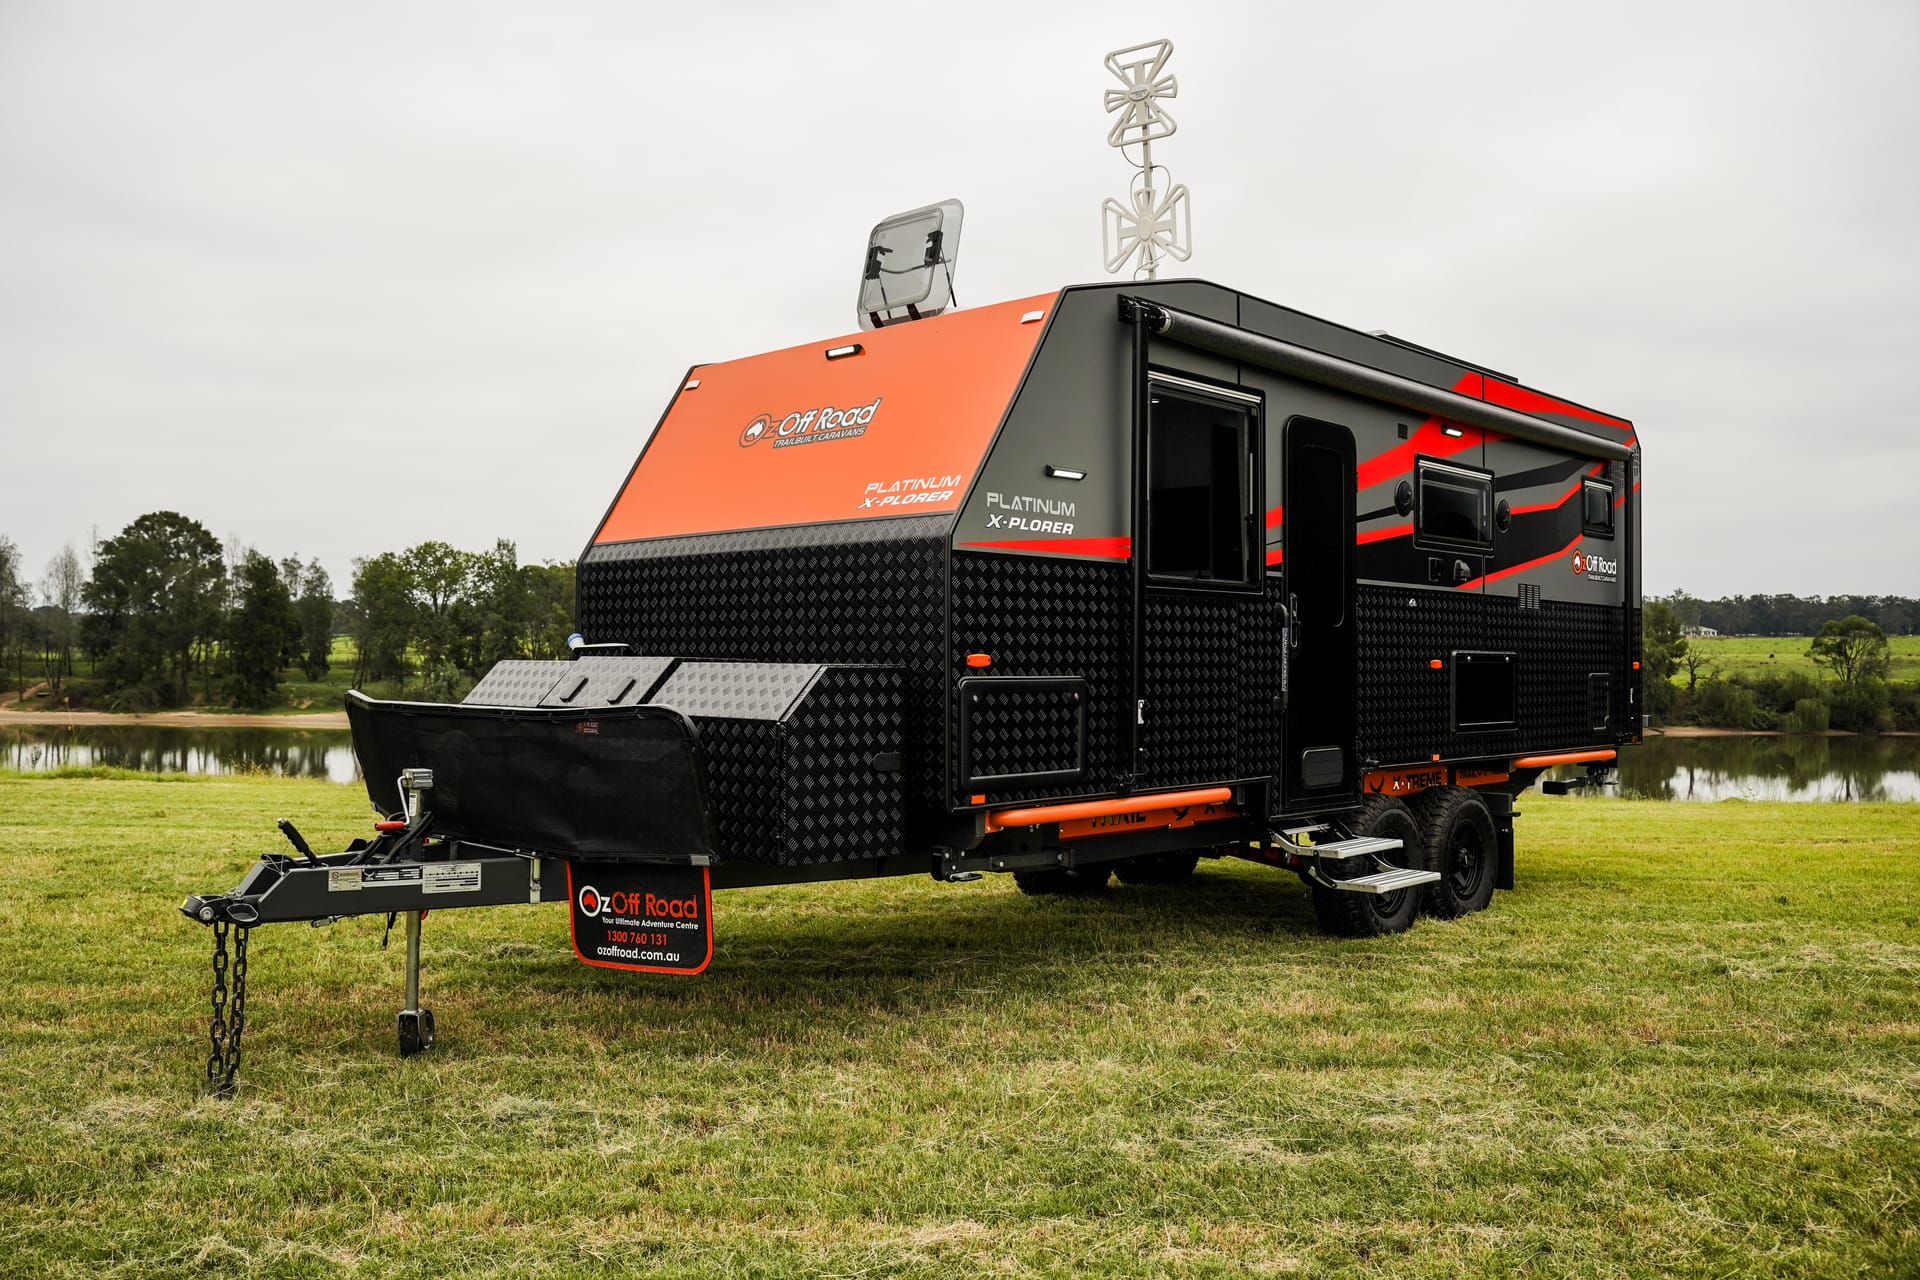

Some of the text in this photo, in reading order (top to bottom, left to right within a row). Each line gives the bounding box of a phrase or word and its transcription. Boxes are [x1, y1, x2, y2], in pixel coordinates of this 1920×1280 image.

[812, 397, 882, 432] Road
[818, 427, 866, 441] CARAVANS
[864, 475, 962, 495] PLATINUM
[856, 490, 954, 510] X-PLORER
[987, 492, 1076, 517] PLATINUM
[986, 513, 1075, 535] X-PLORER
[1599, 556, 1617, 575] Road
[645, 893, 698, 919] Road
[602, 916, 699, 930] Your Ultimate Adventure Centre
[607, 930, 667, 946] 1300 760 131
[597, 945, 680, 962] ozoffroad.com.au
